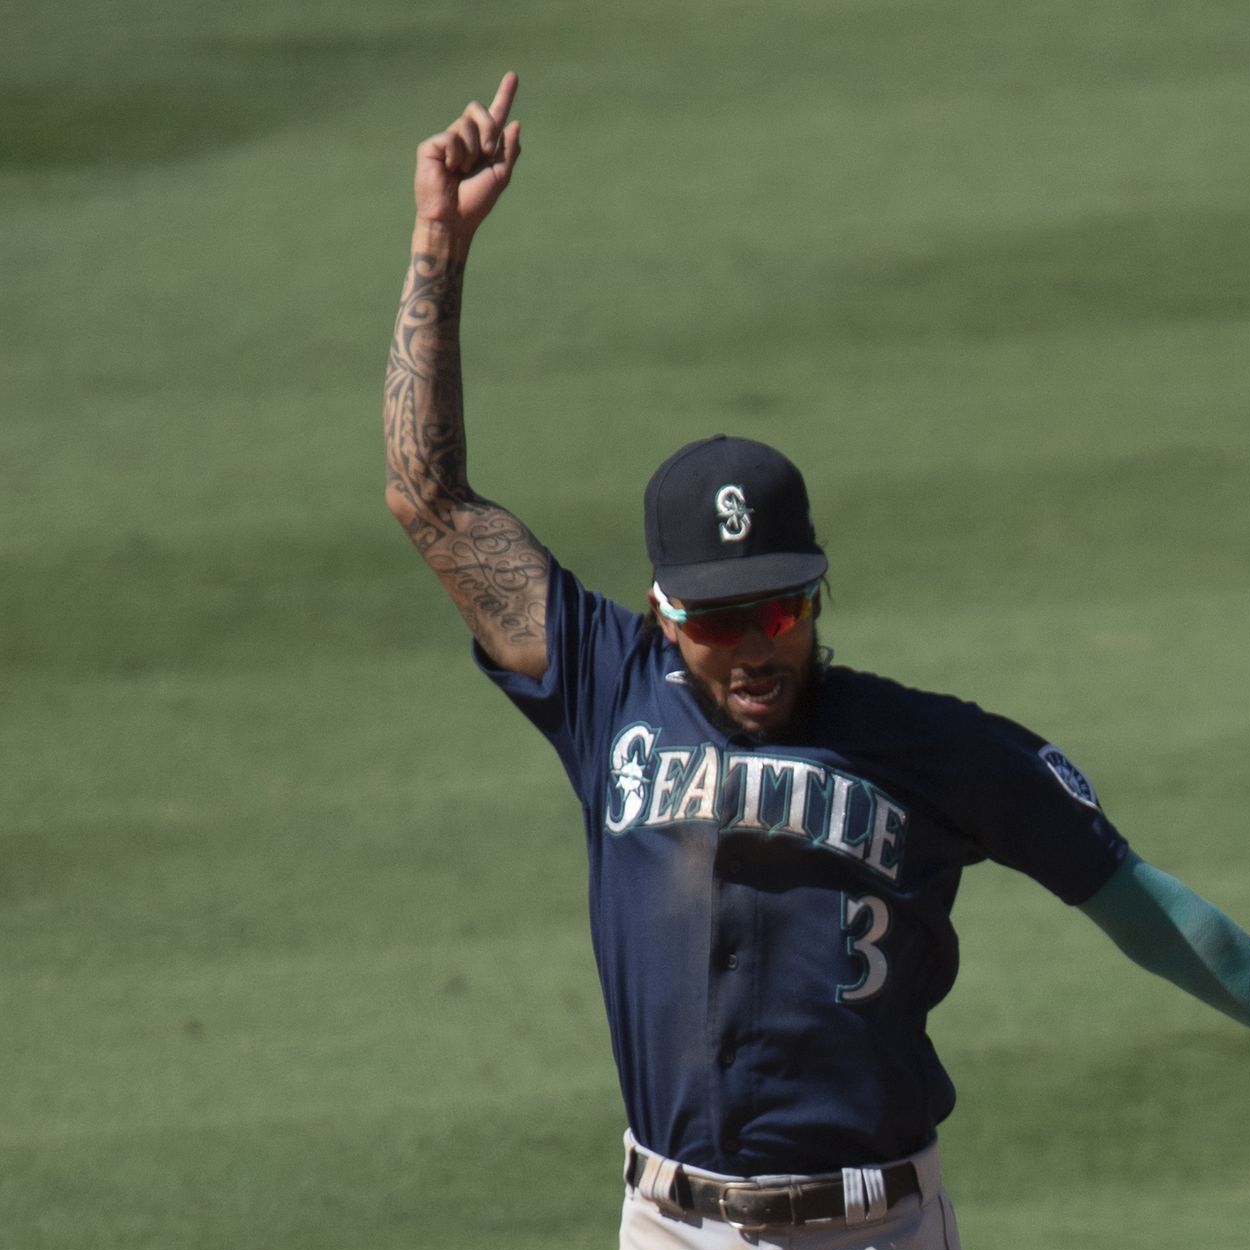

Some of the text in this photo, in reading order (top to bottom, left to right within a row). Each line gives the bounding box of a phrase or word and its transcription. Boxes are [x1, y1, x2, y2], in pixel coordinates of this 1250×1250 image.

[714, 484, 755, 542] S
[603, 720, 908, 882] SEATTLE
[836, 892, 891, 1004] 3
